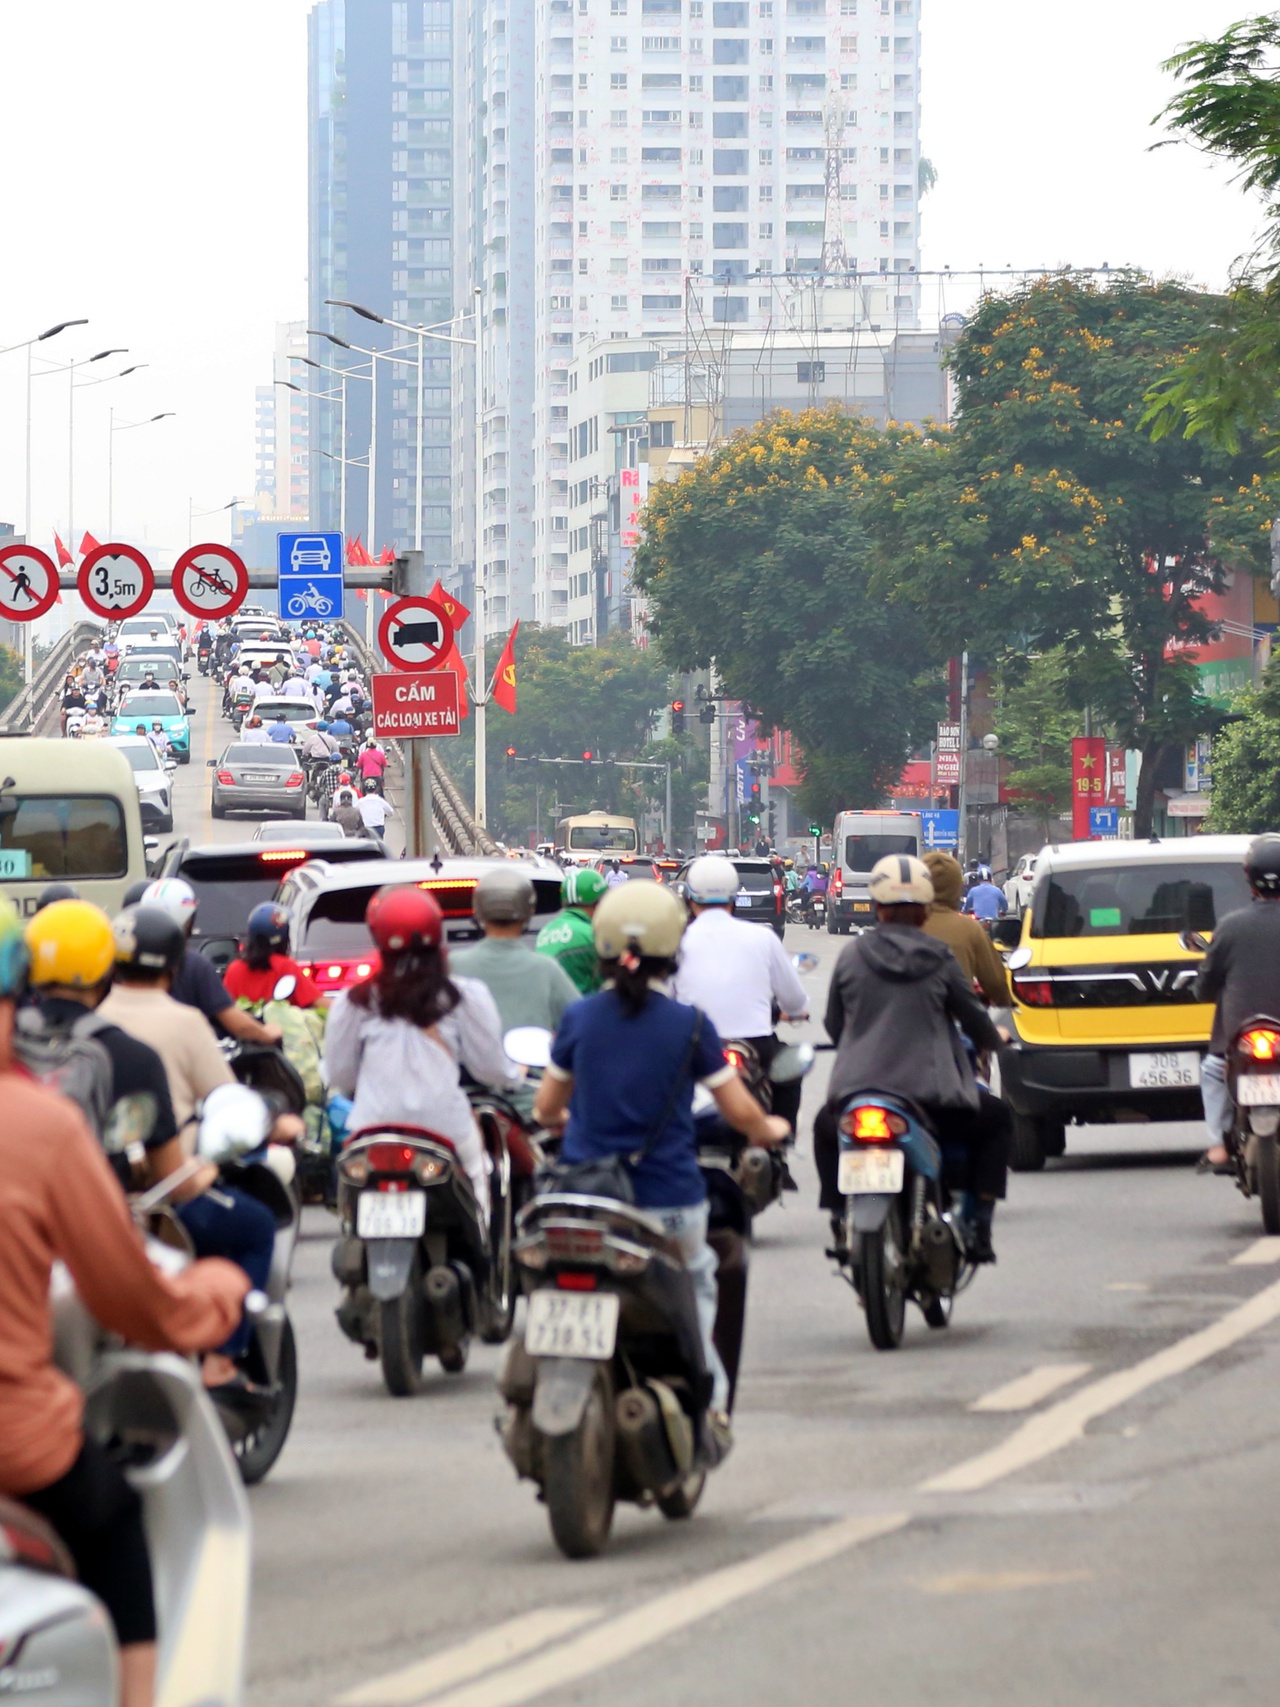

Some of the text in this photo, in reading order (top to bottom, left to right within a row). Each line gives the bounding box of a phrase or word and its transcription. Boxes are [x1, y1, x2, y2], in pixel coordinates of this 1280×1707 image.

[95, 566, 136, 600] 3,5m
[395, 680, 436, 702] CẤM
[377, 706, 456, 729] CÁC LOẠI XE TẢI
[735, 719, 746, 742] Liv
[938, 753, 958, 763] NHÀ
[1076, 777, 1101, 792] 19-5
